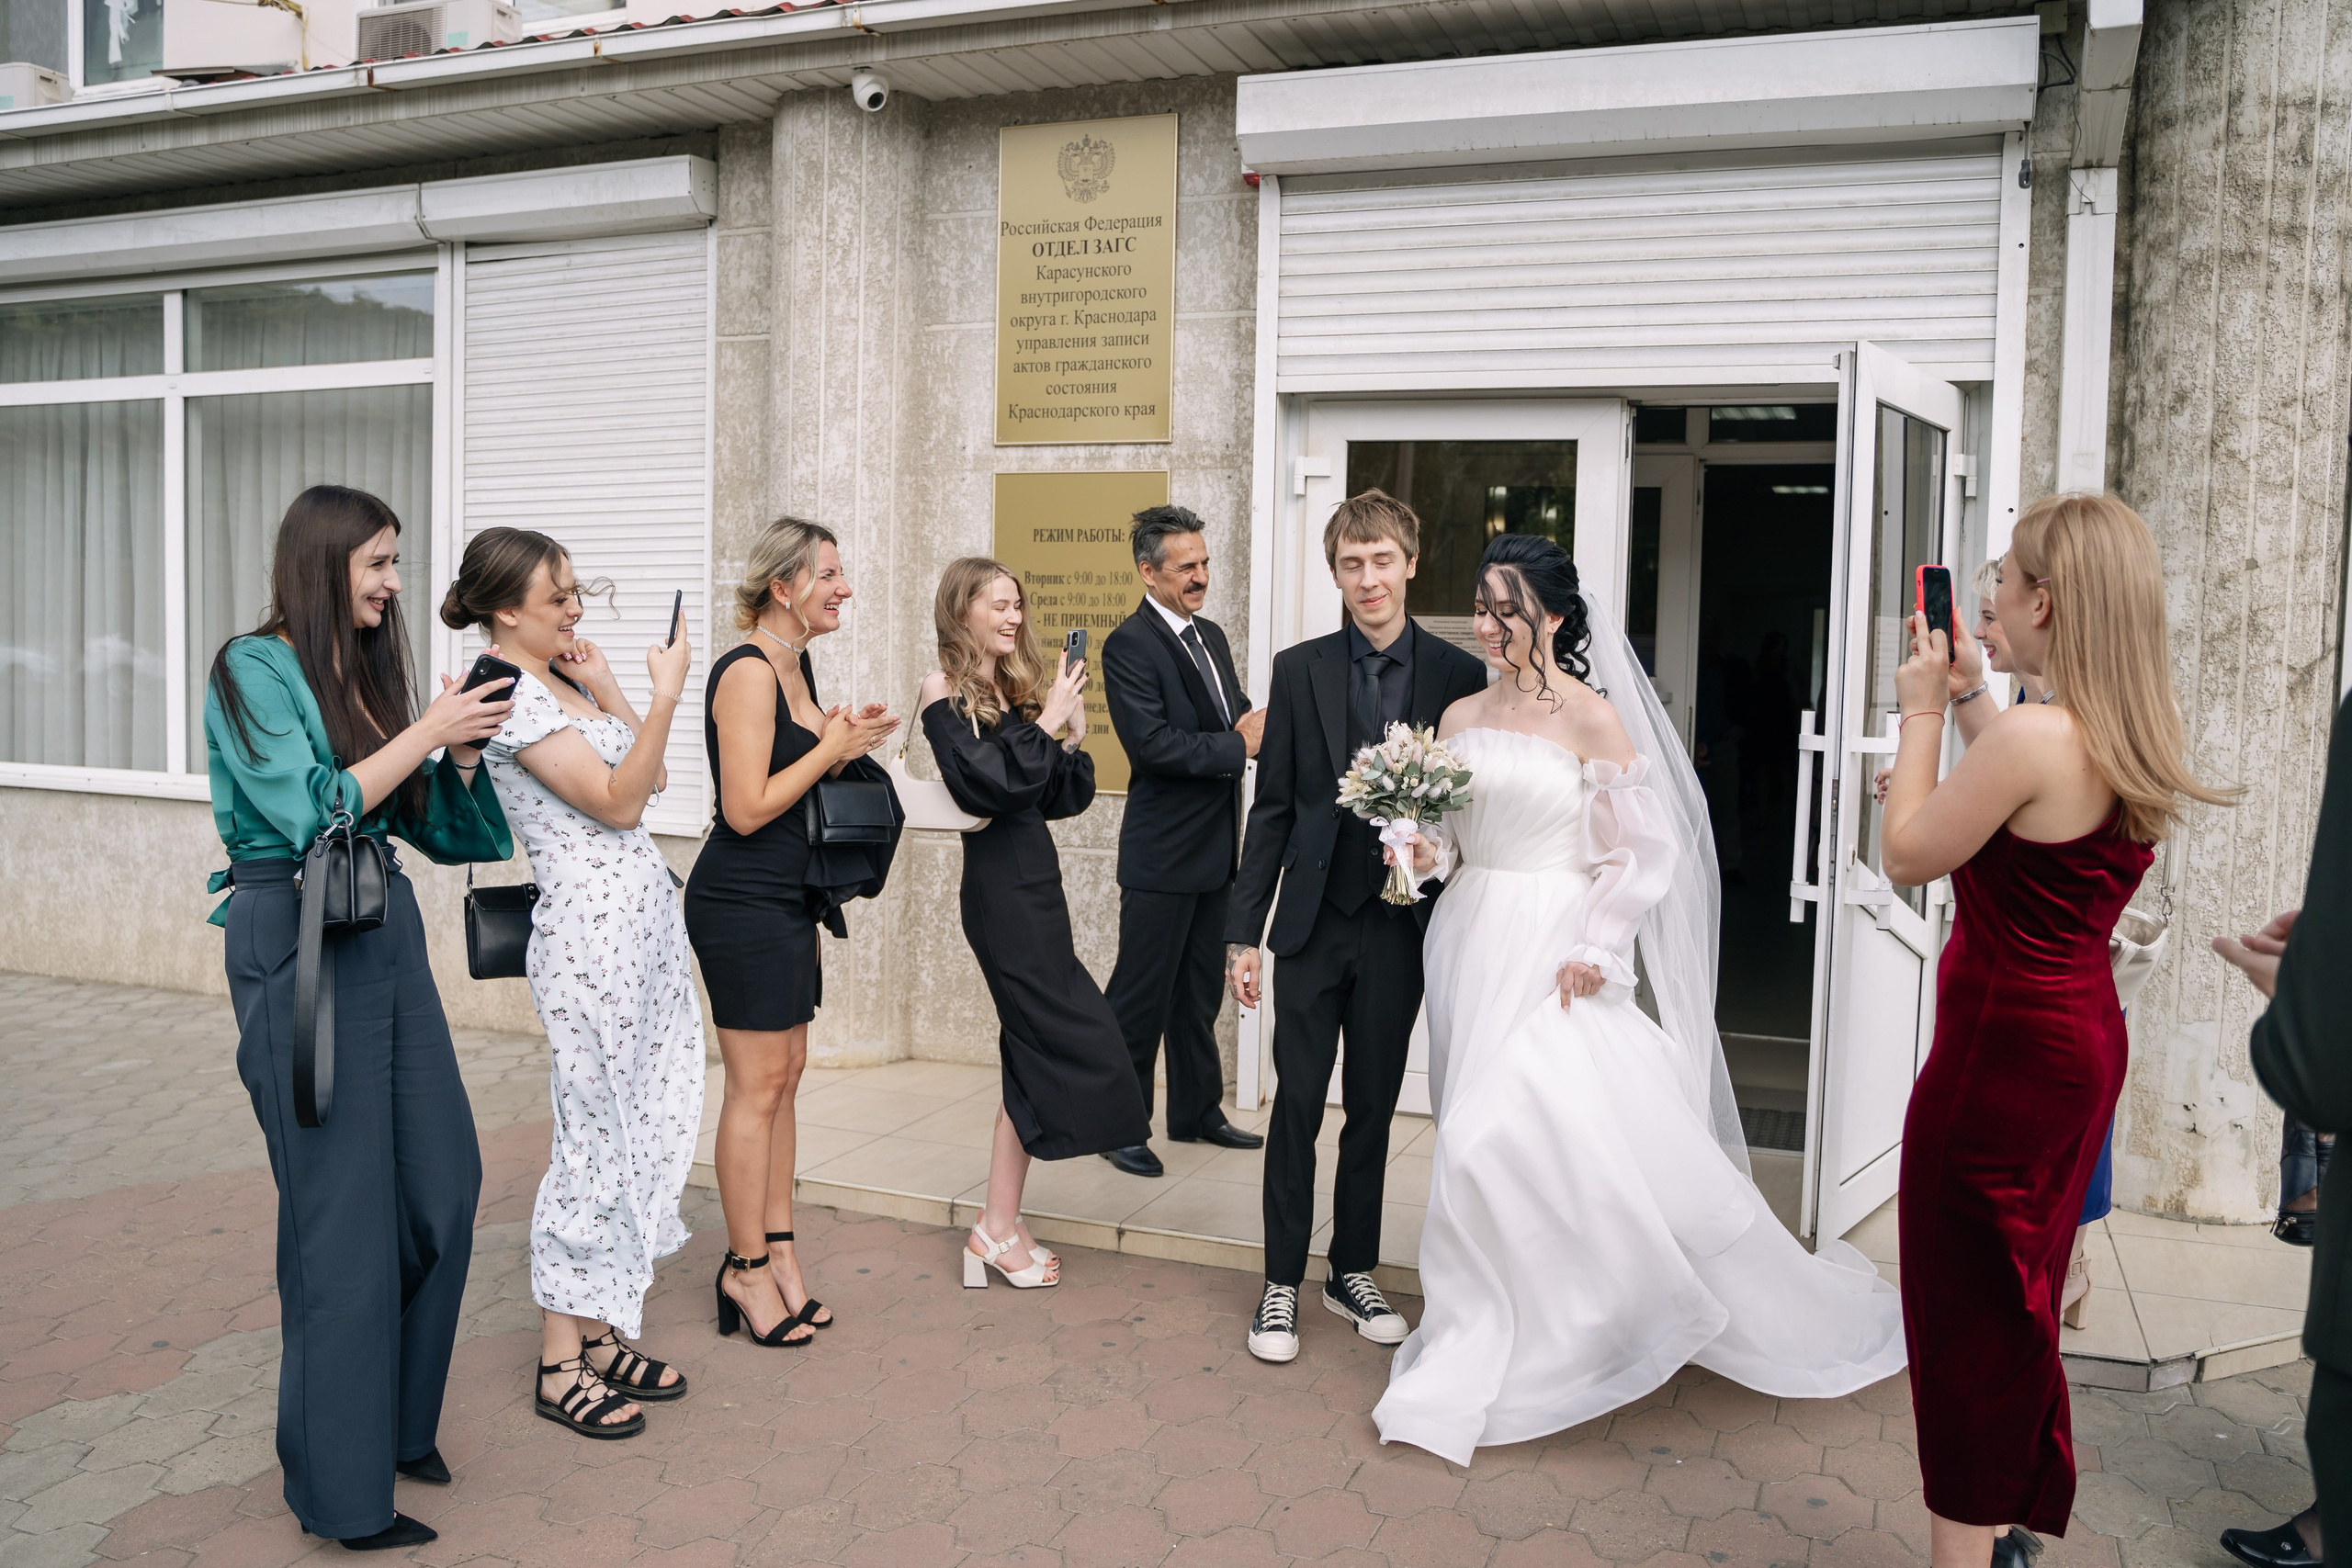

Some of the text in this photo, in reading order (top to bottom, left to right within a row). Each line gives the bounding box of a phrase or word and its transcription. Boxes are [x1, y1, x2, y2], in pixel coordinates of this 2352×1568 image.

[1001, 216, 1162, 236] Российская Федерация
[1032, 236, 1136, 258] ОТДЕЛ ЗАГС
[1036, 264, 1132, 283] Карасунского
[1021, 287, 1147, 307] внутригородского
[1011, 310, 1157, 331] округа г. Краснодара
[1016, 333, 1149, 354] управления записи
[1013, 357, 1152, 376] актов гражданского
[1046, 382, 1117, 395] состояния
[1008, 404, 1156, 423] Краснодарского края
[1033, 528, 1125, 543] РЕЖИМ РАБОТЫ:
[1024, 570, 1133, 588] Вторник с 9:00 до 18:00
[1030, 592, 1126, 609] Среда с 9:00 до 18:00
[1043, 613, 1058, 626] НЕ
[1091, 724, 1109, 734] дни
